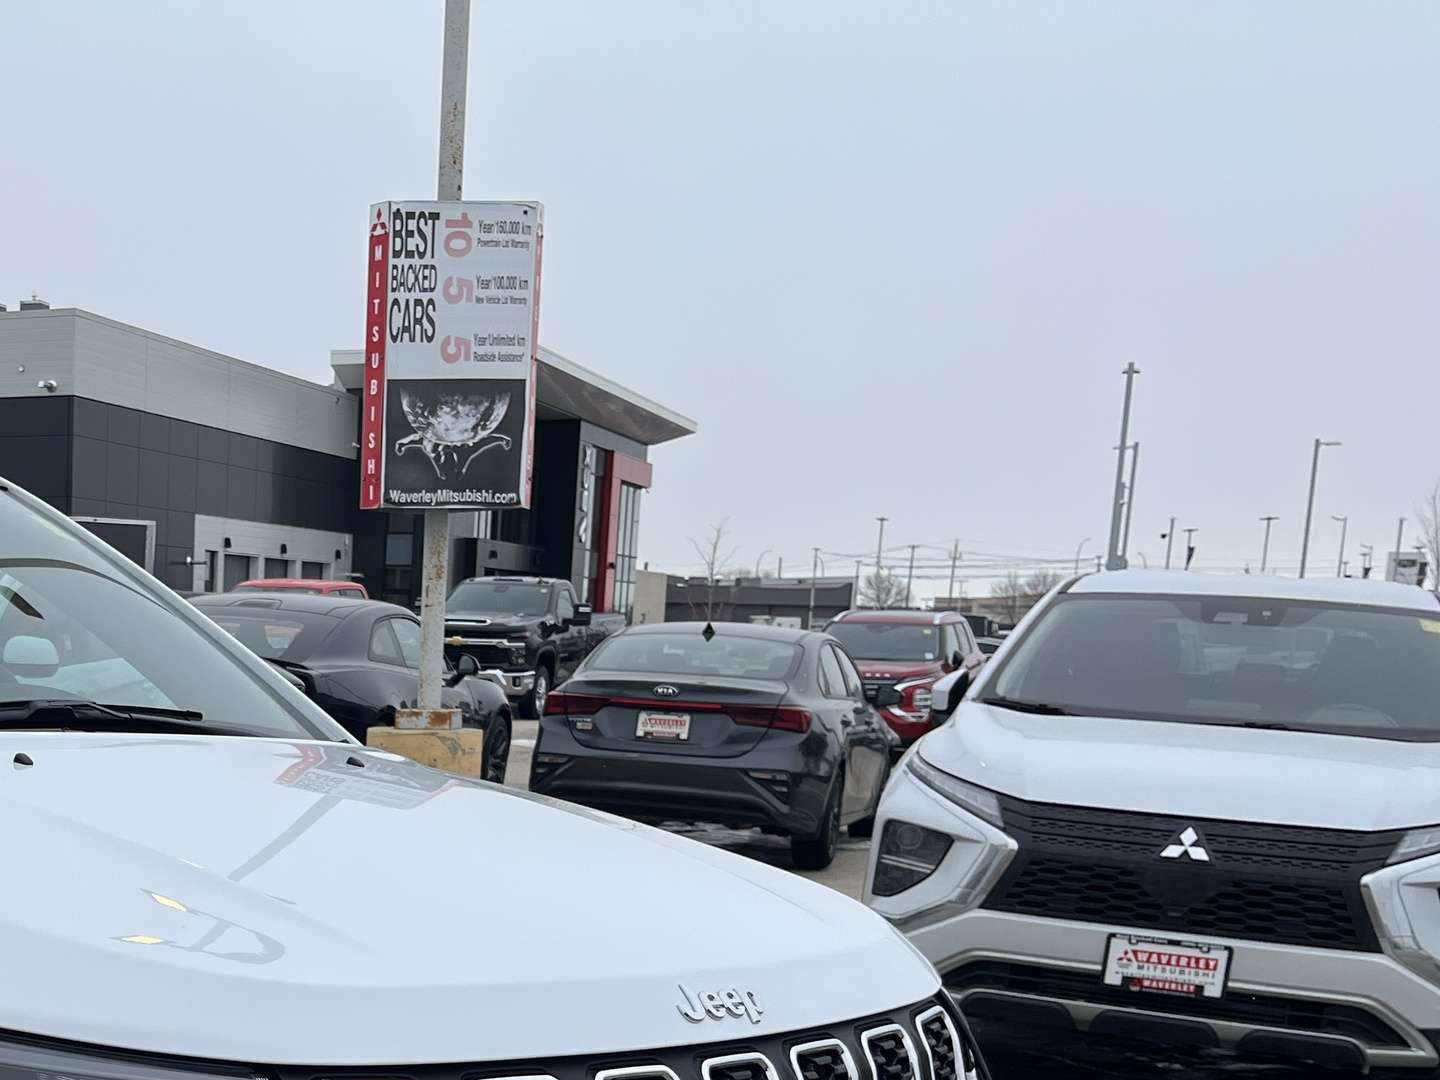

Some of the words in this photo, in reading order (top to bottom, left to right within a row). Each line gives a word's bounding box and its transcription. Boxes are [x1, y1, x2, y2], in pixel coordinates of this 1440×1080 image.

[391, 210, 441, 260] BEST
[443, 212, 473, 258] 10
[478, 219, 494, 233] Year
[521, 221, 531, 235] km
[390, 264, 438, 293] BACKED
[442, 276, 473, 305] 5
[476, 275, 492, 290] Year
[519, 276, 528, 290] km
[389, 298, 436, 344] CARS
[440, 335, 472, 364] 5
[473, 333, 488, 346] Year
[488, 333, 516, 346] Unlimited
[517, 333, 526, 347] km
[367, 244, 383, 500] MITSUBISHI
[389, 489, 517, 505] WaverleyMitsubishi.com
[1136, 950, 1218, 970] WAVERLEY
[1136, 964, 1216, 979] MITSUBISHI
[1142, 979, 1195, 993] WAVERLEY
[675, 984, 764, 1025] Jeep
